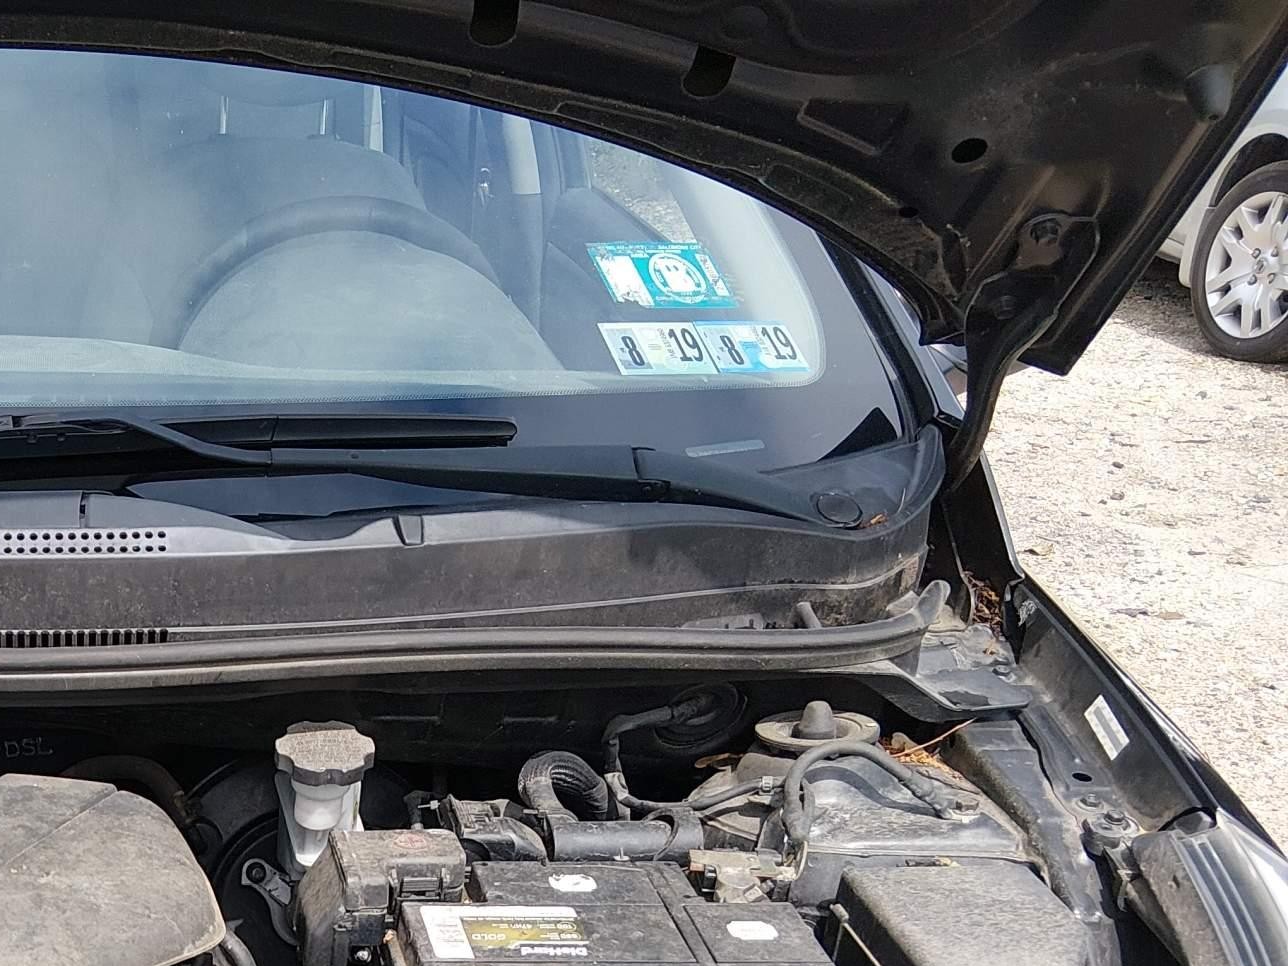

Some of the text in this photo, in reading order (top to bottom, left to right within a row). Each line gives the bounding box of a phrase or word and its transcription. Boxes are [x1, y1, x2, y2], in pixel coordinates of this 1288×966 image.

[620, 335, 646, 367] 8
[668, 327, 704, 362] 19
[719, 335, 745, 365] 8
[761, 326, 798, 361] 19
[520, 946, 588, 956] DieHard
